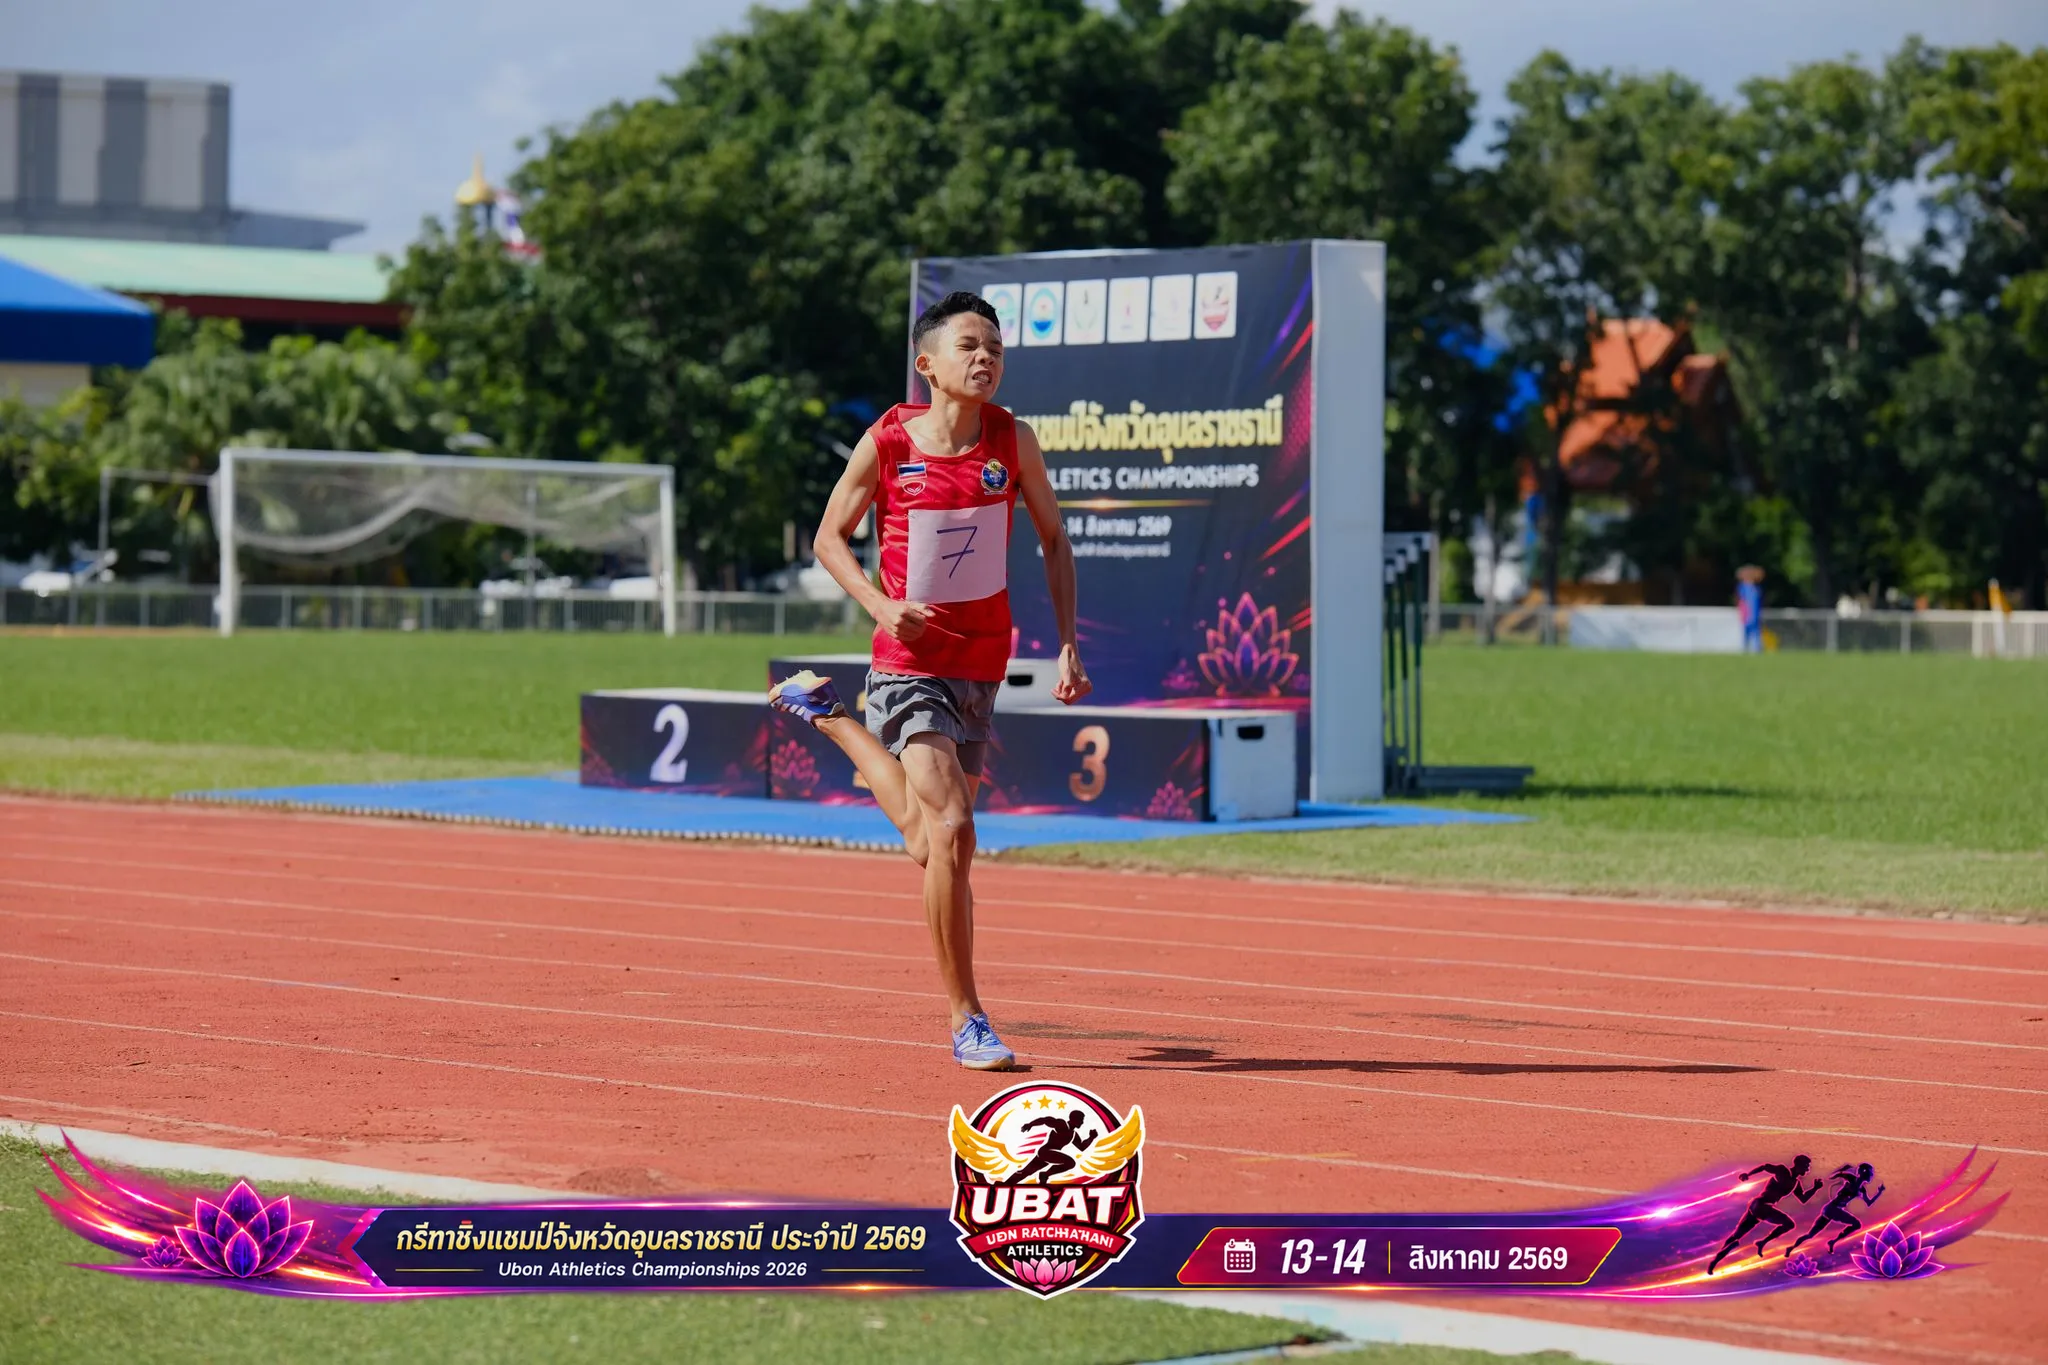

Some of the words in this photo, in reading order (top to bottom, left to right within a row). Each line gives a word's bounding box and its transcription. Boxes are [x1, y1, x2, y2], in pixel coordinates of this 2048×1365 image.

[1047, 466, 1112, 491] LETICS
[1115, 463, 1260, 490] CHAMPIONSHIPS
[936, 525, 978, 579] 7
[649, 703, 689, 783] 2
[1069, 725, 1112, 802] 3
